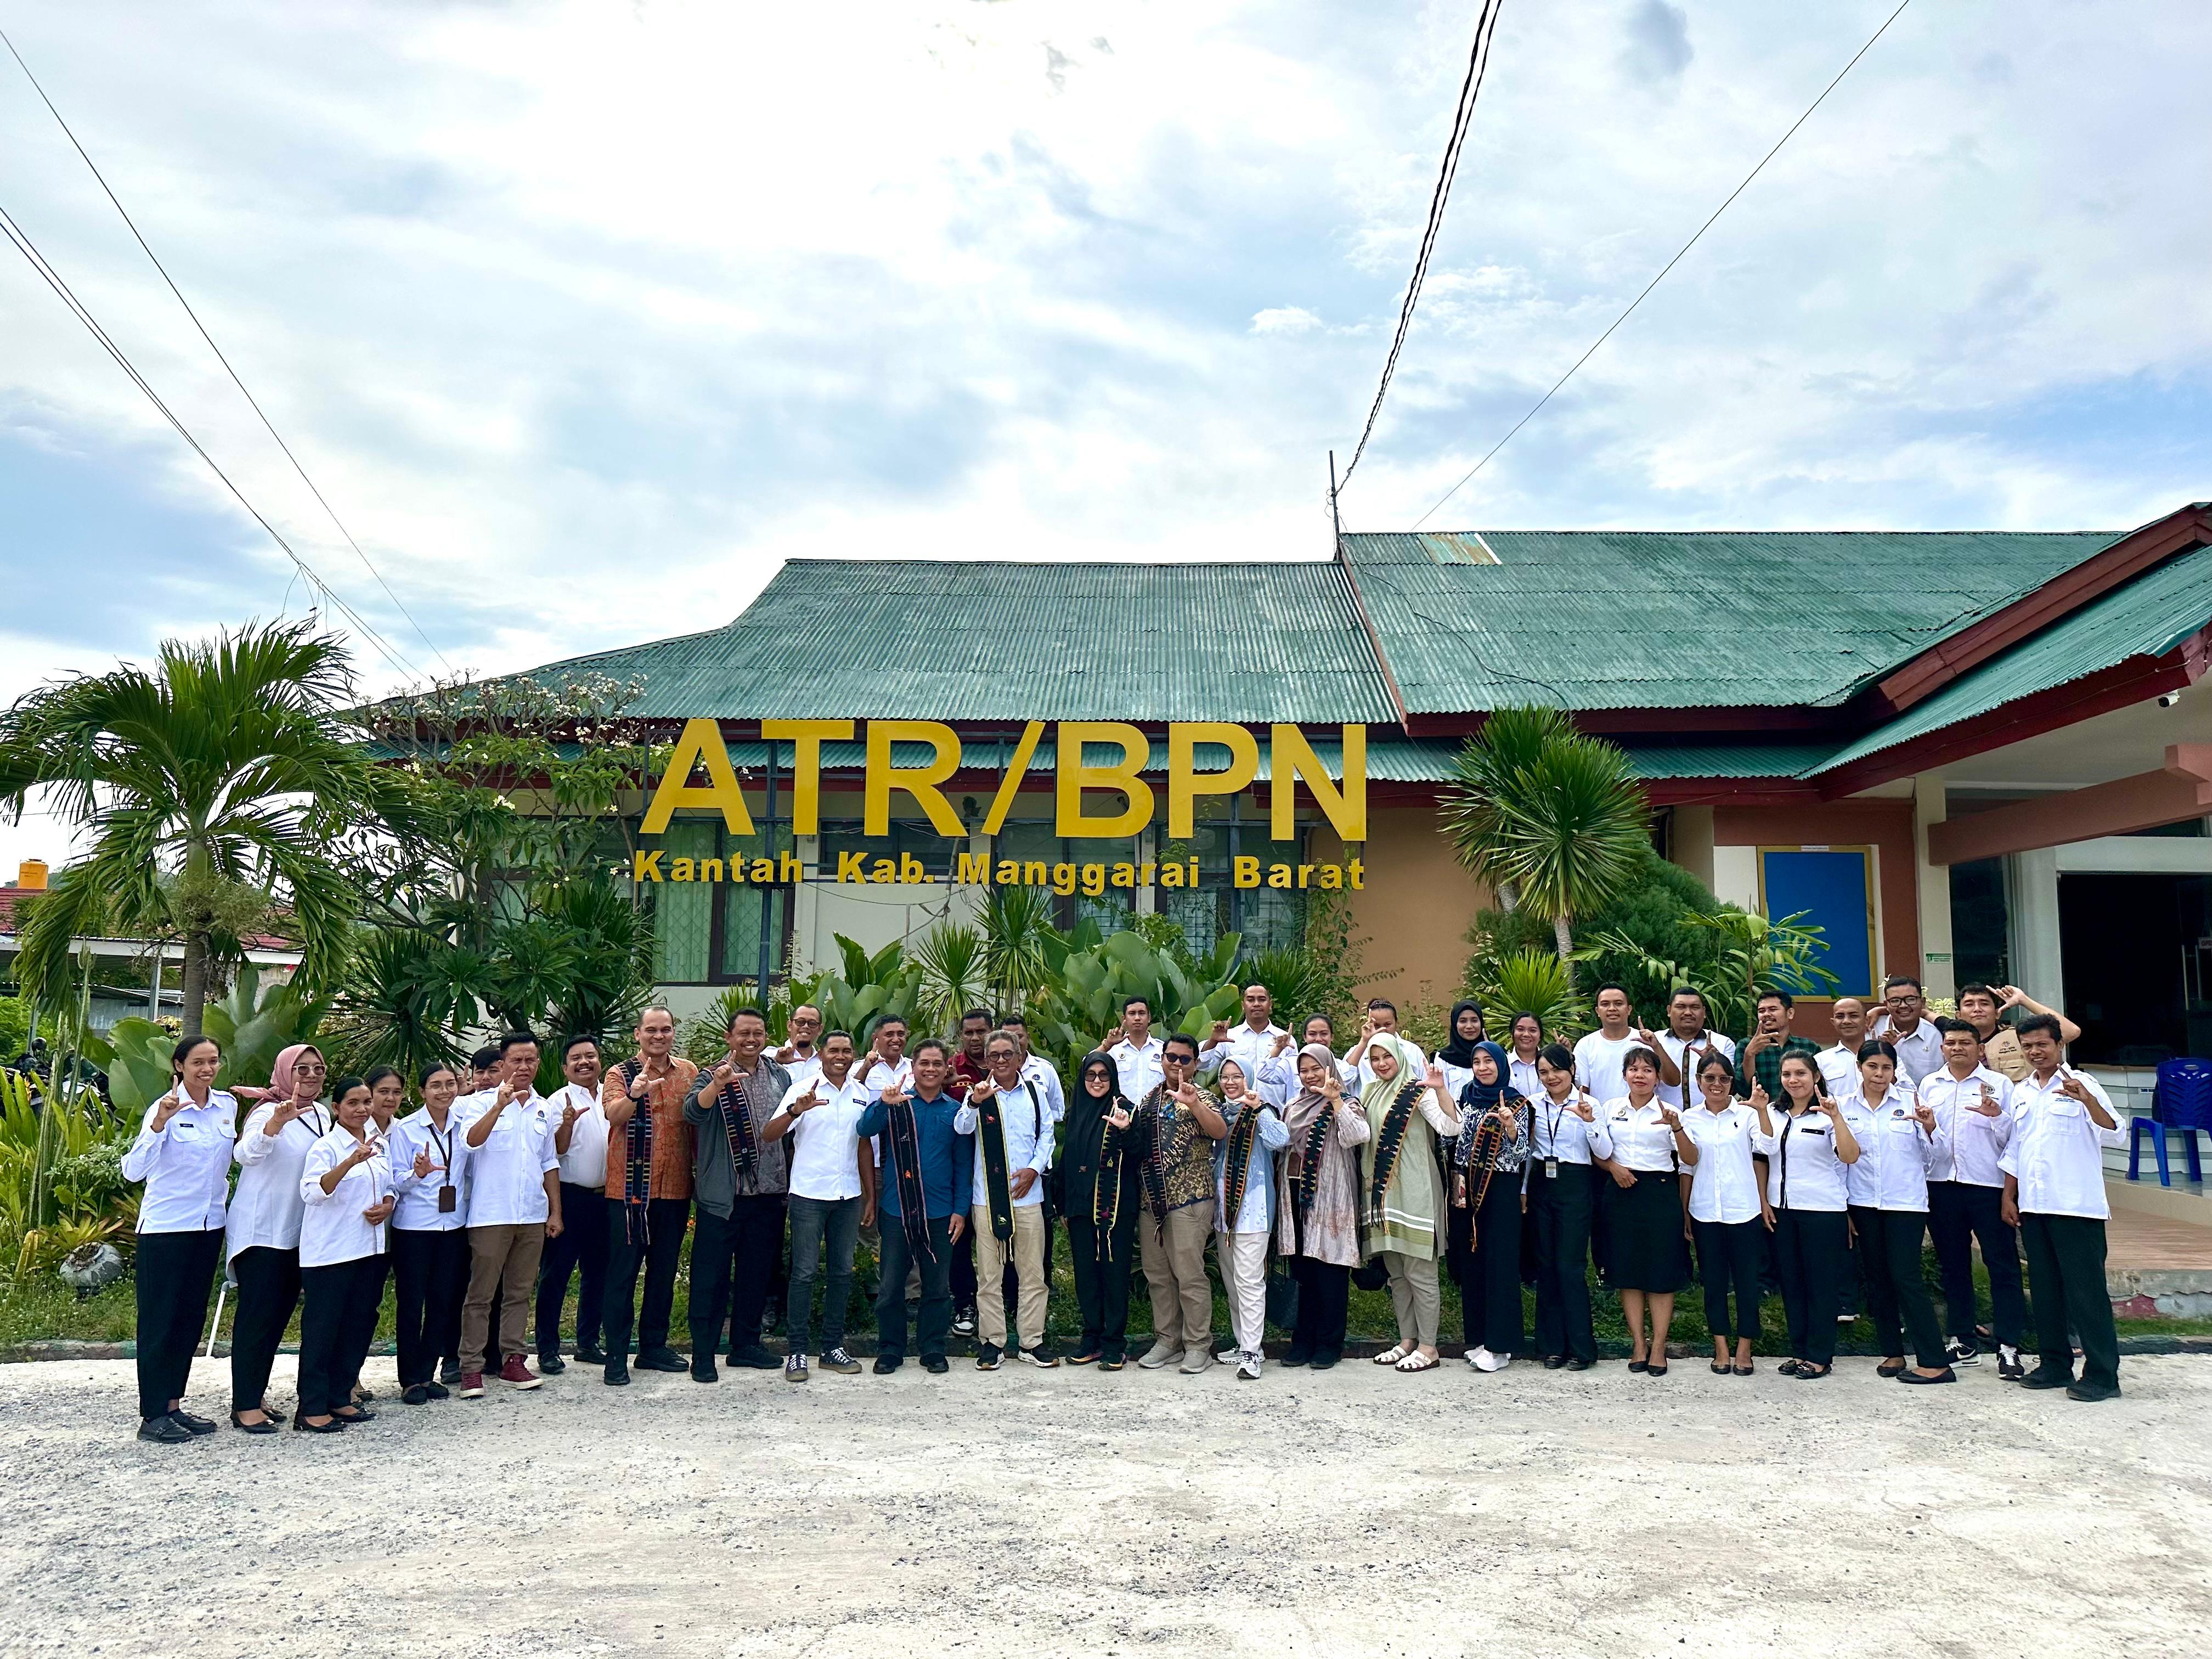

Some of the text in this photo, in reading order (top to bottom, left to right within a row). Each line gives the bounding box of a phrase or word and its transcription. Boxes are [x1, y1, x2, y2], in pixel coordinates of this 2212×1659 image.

[640, 718, 1367, 841] ATR/BPN
[635, 850, 1365, 896] Kantah Kab. Manggarai Barat
